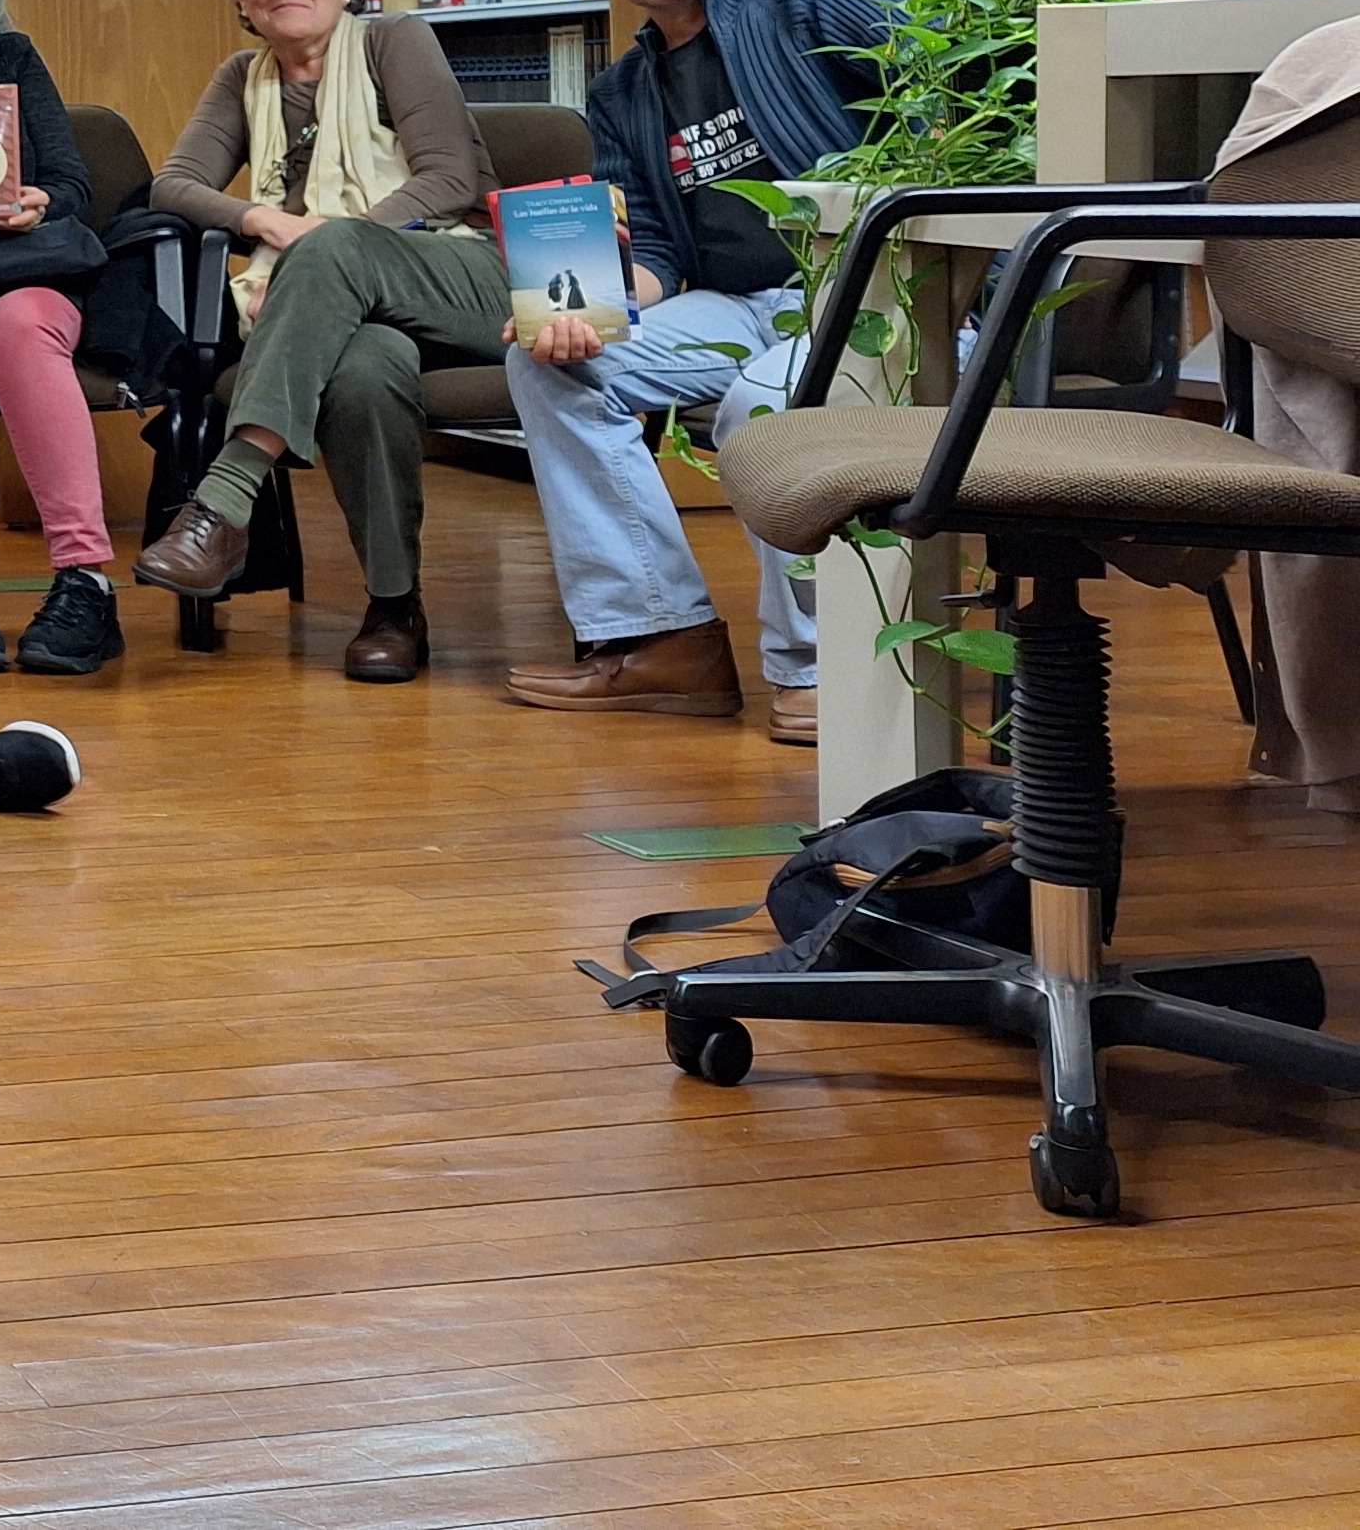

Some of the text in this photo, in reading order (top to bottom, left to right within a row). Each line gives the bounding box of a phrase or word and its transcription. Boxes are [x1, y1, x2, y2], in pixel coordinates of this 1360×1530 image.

[513, 202, 599, 218] Las huellas de la vida
